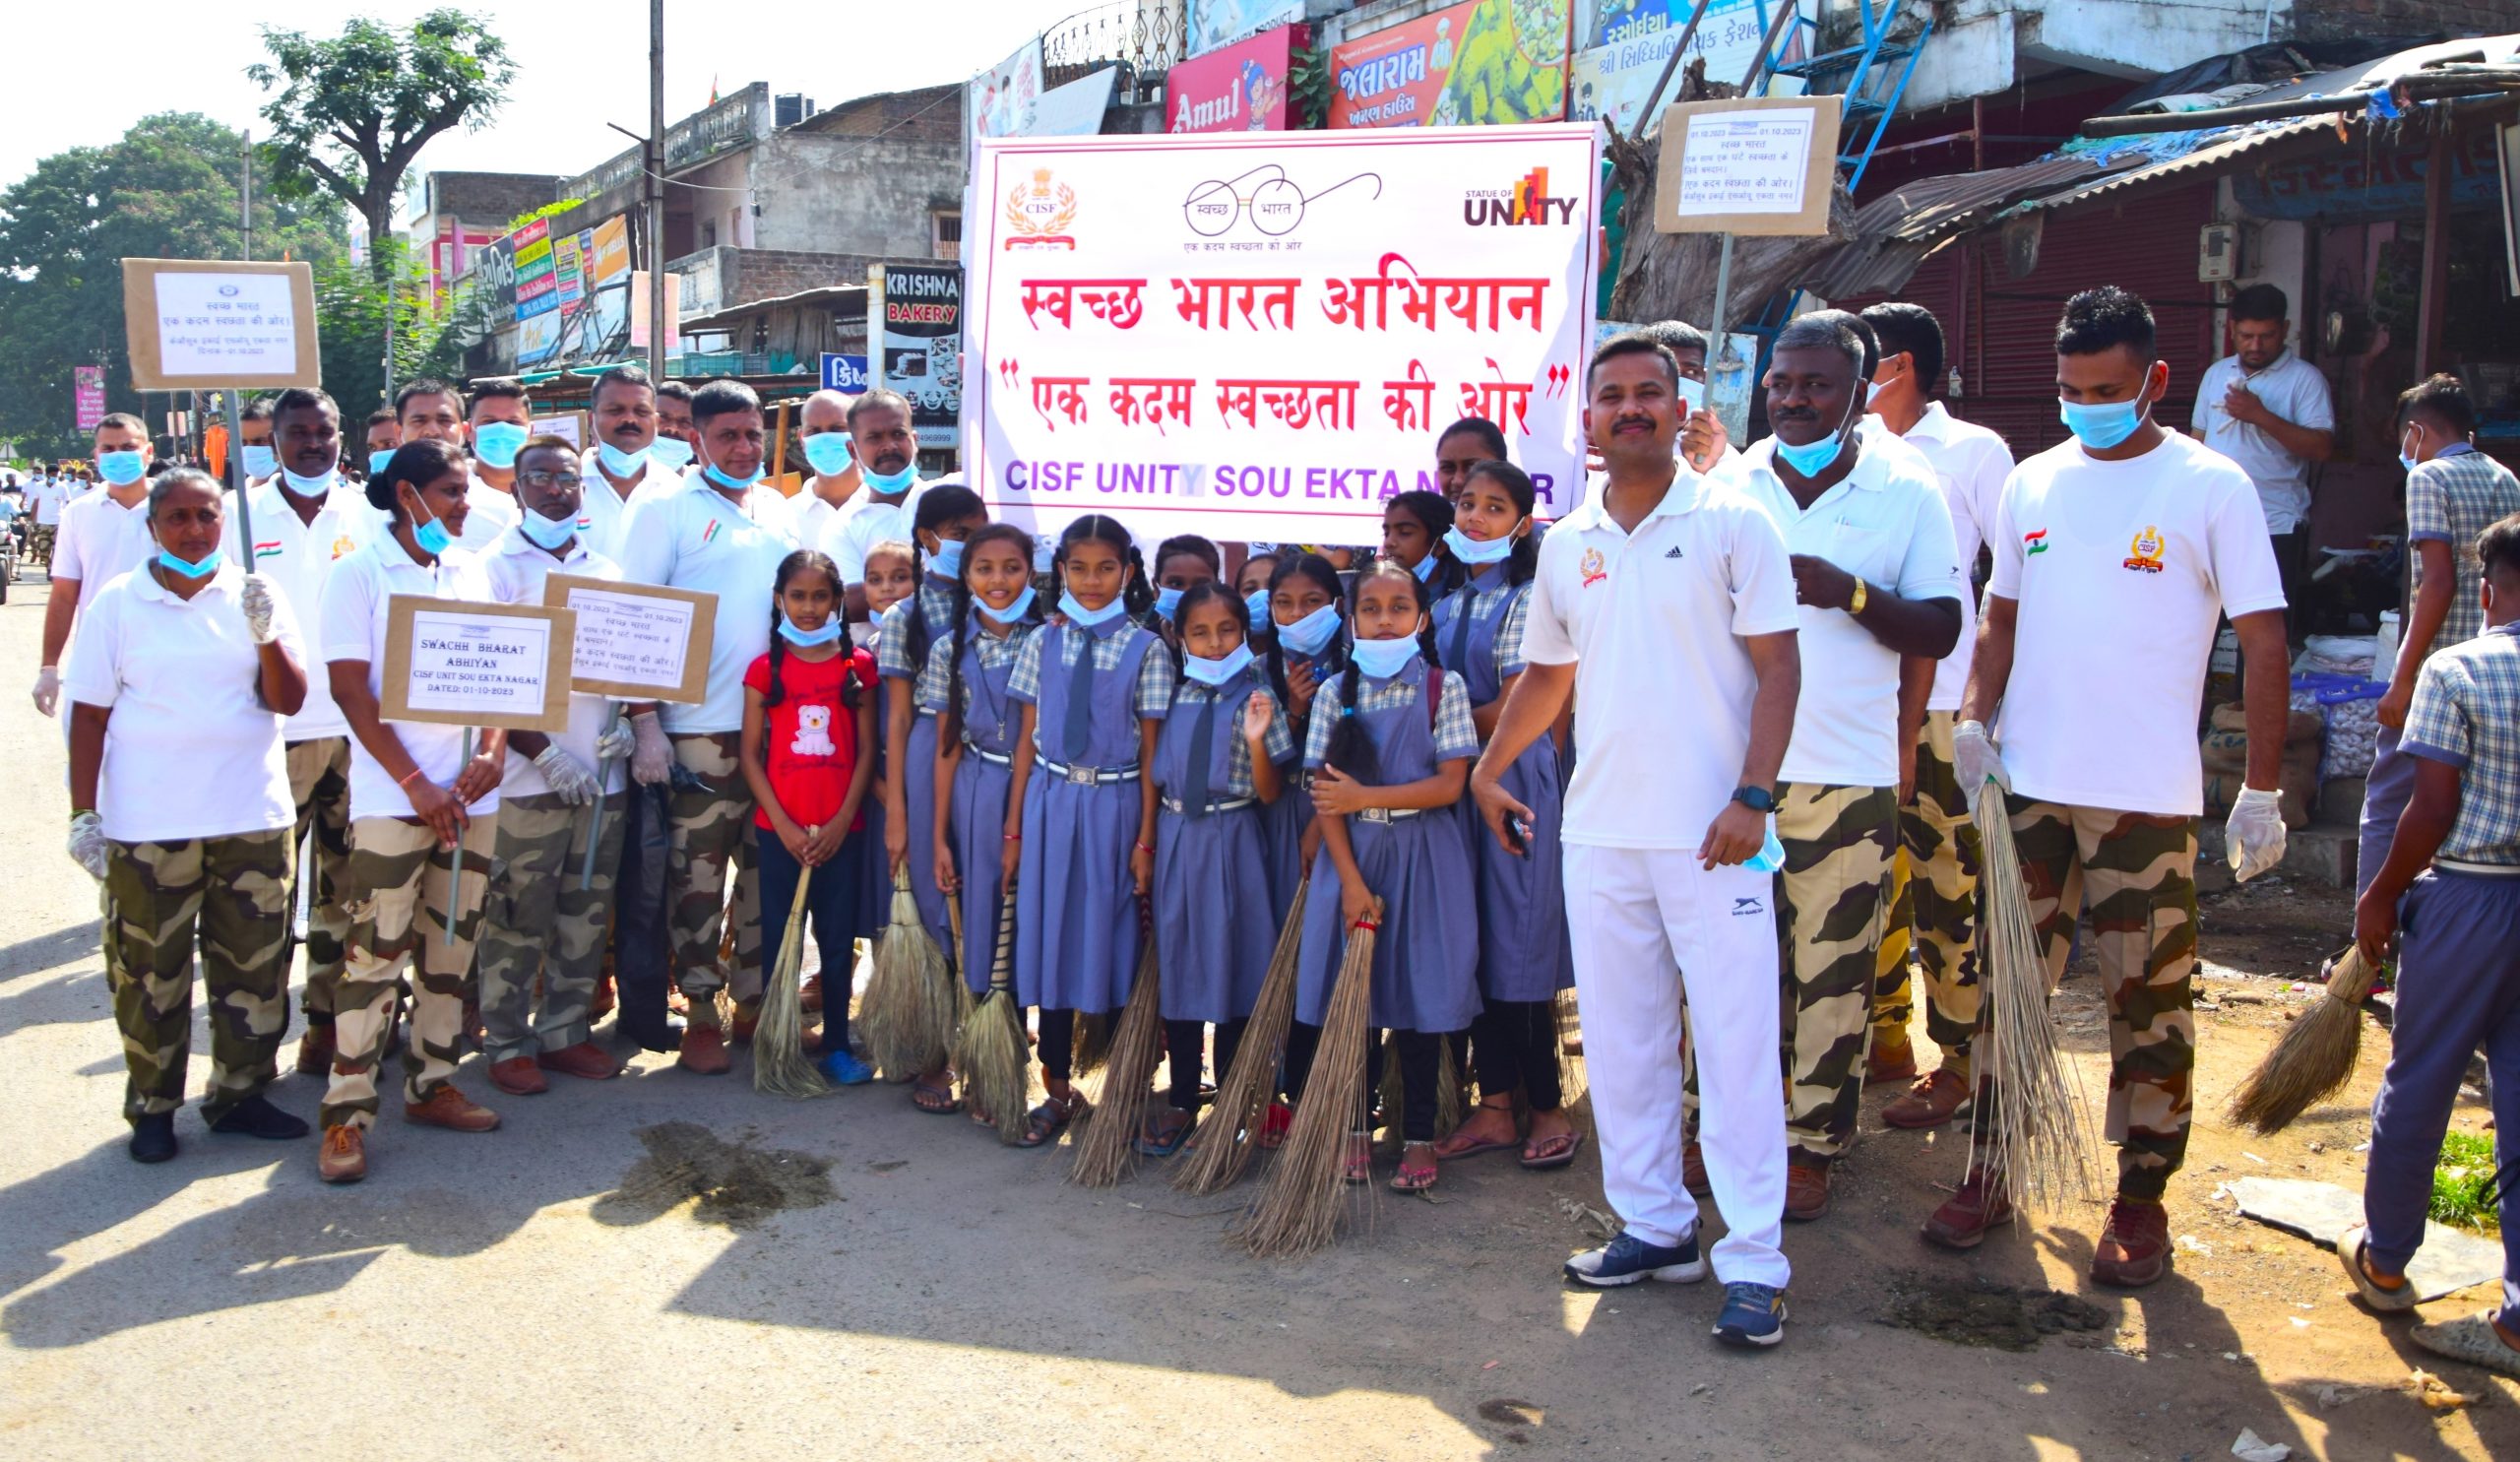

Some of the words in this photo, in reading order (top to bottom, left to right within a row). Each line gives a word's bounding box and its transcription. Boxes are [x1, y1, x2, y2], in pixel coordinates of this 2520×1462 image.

[1598, 49, 1615, 74] શ્રી
[1339, 43, 1426, 100] જલારામ
[1173, 78, 1240, 132] Amul
[1759, 127, 1802, 136] 01.10.2023
[1025, 203, 1057, 214] CISF
[1196, 204, 1228, 216] स्वच्छ
[1261, 203, 1292, 216] भारत
[1183, 242, 1200, 254] एक
[1203, 242, 1226, 253] कदम
[1229, 242, 1264, 252] स्वच्छता
[1268, 238, 1281, 251] की
[1285, 238, 1302, 251] ओर
[886, 273, 959, 297] KRISHNA
[1021, 279, 1148, 331] स्वच्छ
[1170, 278, 1301, 332] भारत
[1320, 252, 1550, 333] अभियान
[236, 301, 260, 311] भारत
[887, 301, 958, 325] BAKERY
[162, 316, 180, 327] एक
[185, 316, 211, 326] कदम
[250, 313, 264, 326] की
[1108, 378, 1196, 437] कदम
[1216, 379, 1360, 432] स्वच्छता
[1383, 358, 1436, 432] की
[1005, 460, 1085, 491] CISF
[1214, 465, 1292, 498] SOU
[1304, 468, 1401, 501] EKTA
[571, 603, 610, 614] 01.10.2023
[630, 619, 651, 631] भारत
[644, 612, 683, 624] 01.10.2023
[420, 638, 470, 652] SWACHH
[477, 641, 527, 656] BHARAT
[446, 657, 497, 668] ABHIYAN
[412, 669, 434, 678] CISF
[436, 670, 457, 681] UNIT
[458, 671, 476, 681] SOU
[477, 673, 502, 683] EKTA
[504, 674, 538, 685] NAGAR
[427, 683, 461, 693] DATED:
[463, 684, 515, 696] 01-10-2023
